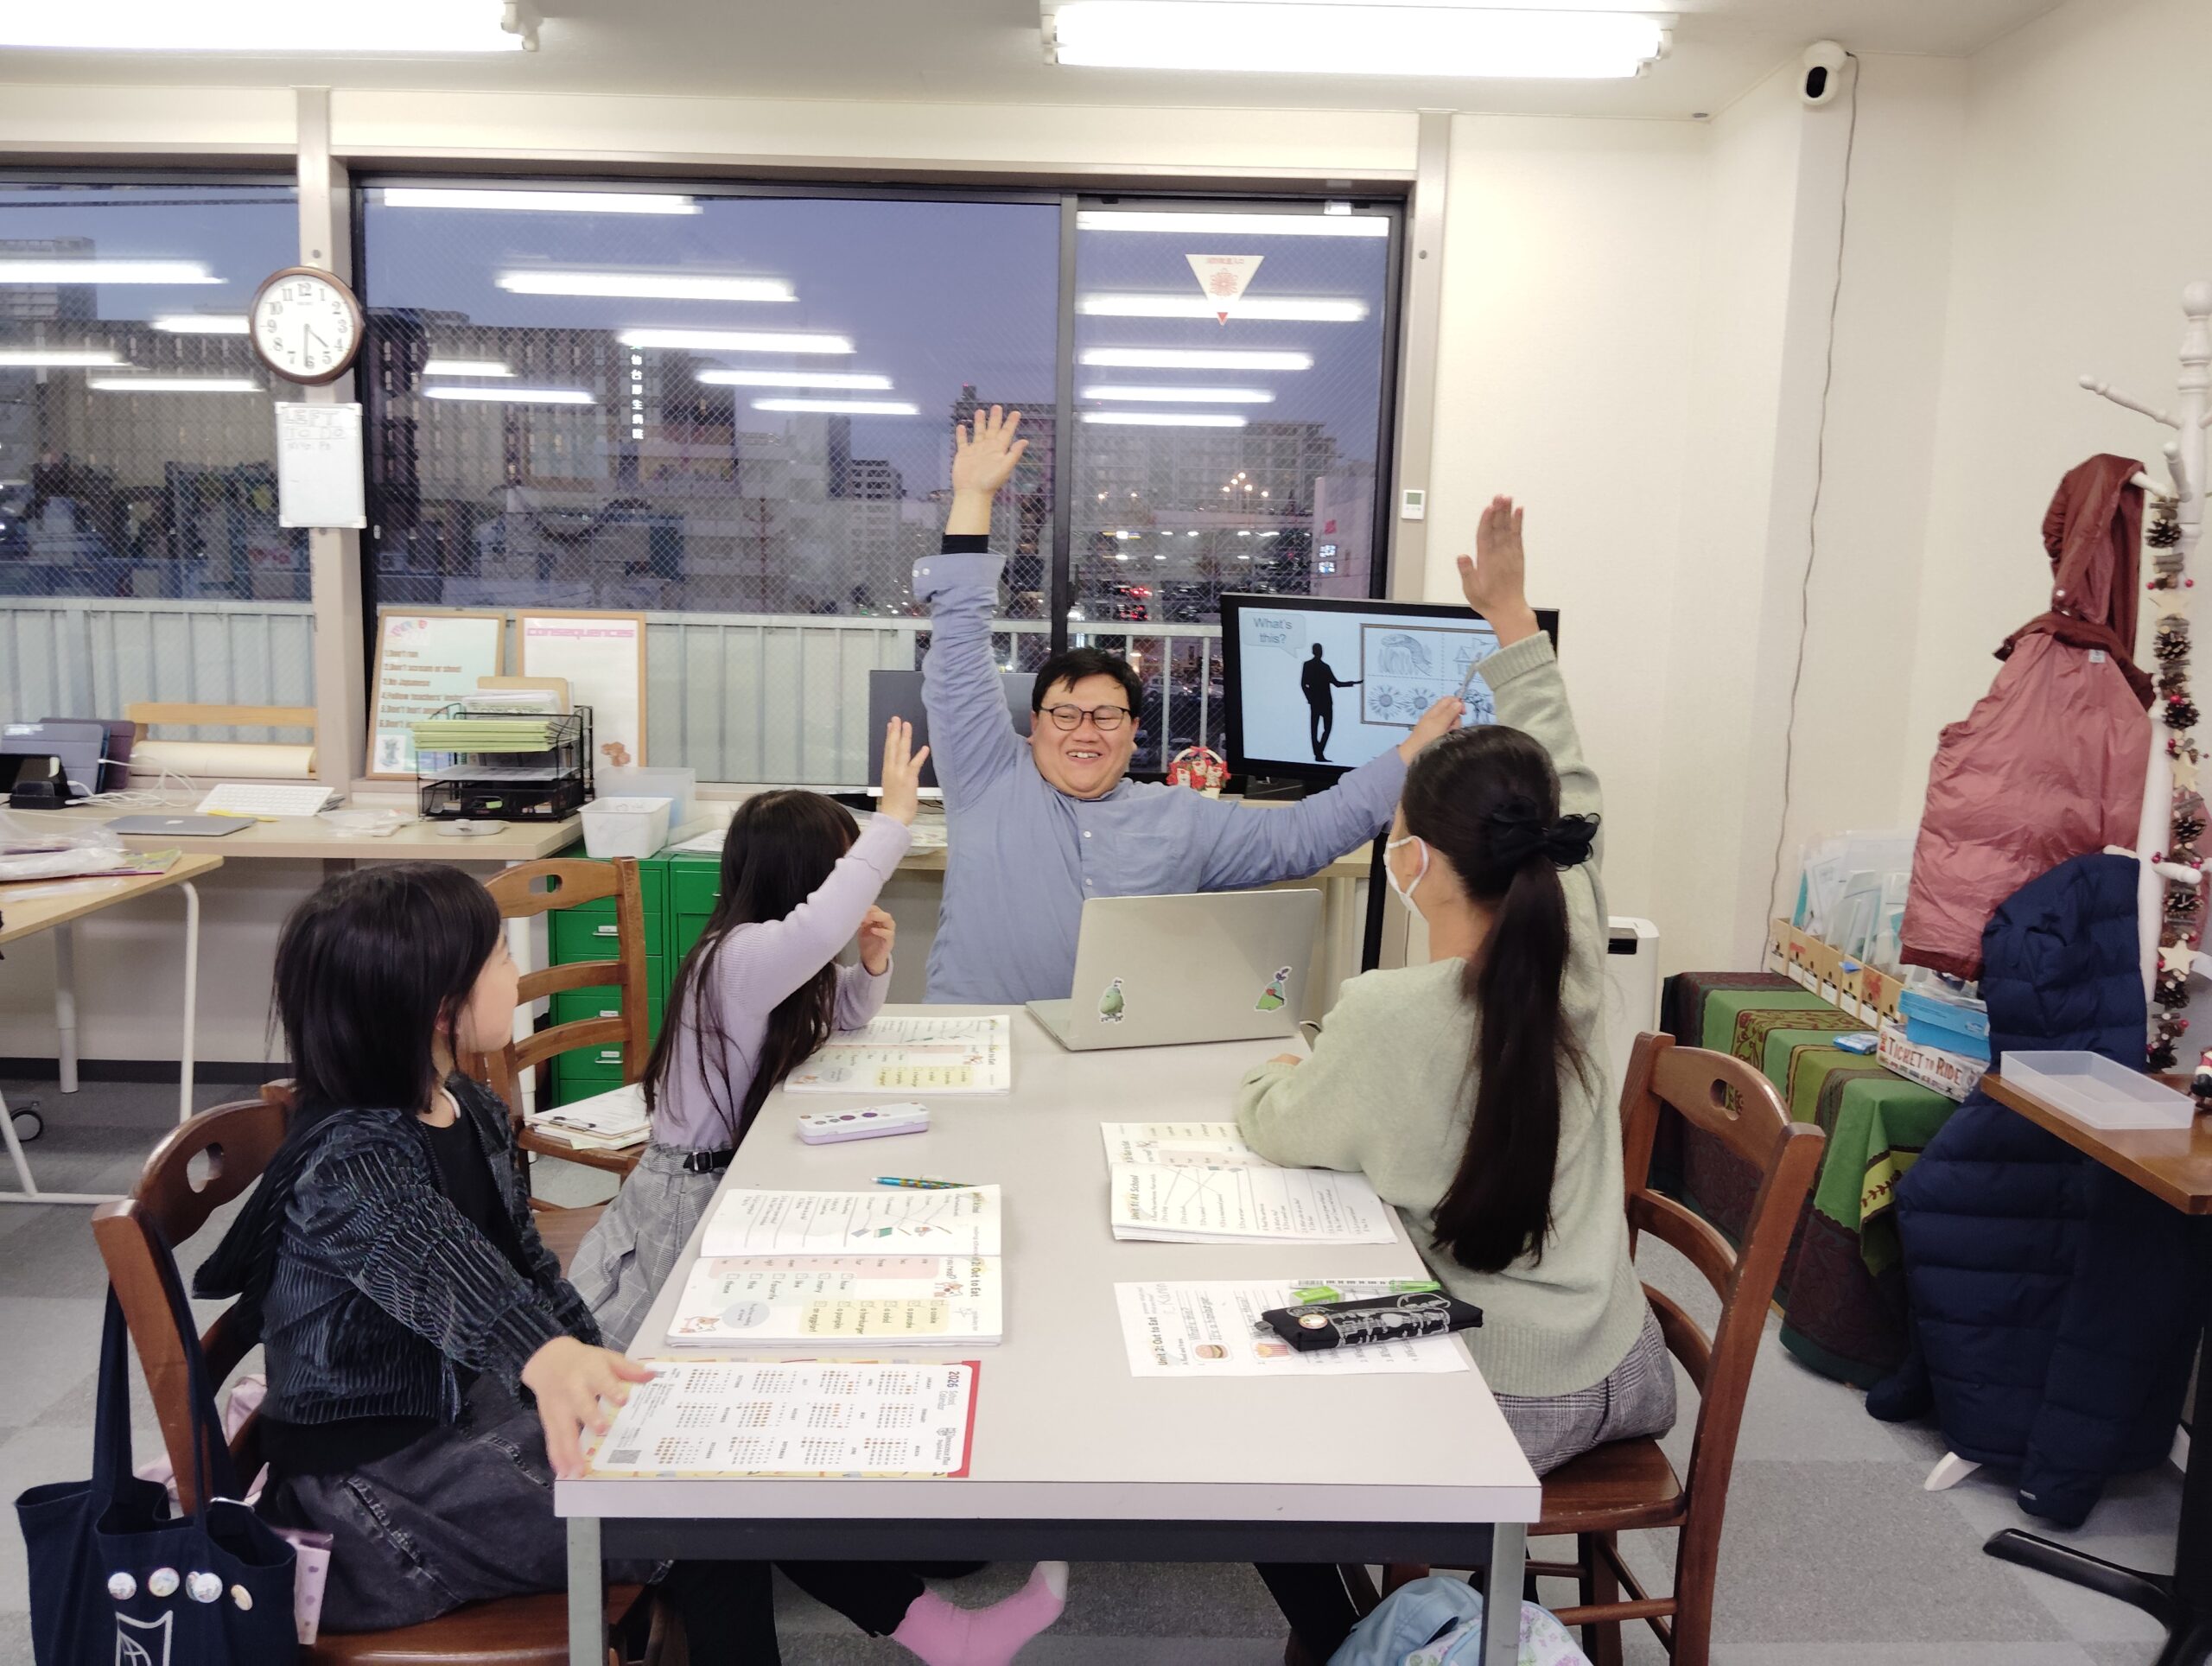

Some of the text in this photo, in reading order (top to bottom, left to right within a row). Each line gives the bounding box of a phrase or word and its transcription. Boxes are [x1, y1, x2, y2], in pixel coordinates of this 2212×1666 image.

[282, 288, 294, 302] 11
[297, 283, 312, 296] 12
[319, 288, 326, 301] 1
[270, 301, 283, 315] 10
[332, 301, 341, 315] 2
[267, 319, 277, 334] 9
[337, 319, 347, 334] 3
[273, 337, 283, 352] 8
[334, 338, 345, 352] 4
[287, 350, 296, 365] 7
[306, 355, 315, 370] 6
[322, 350, 333, 365] 5
[1253, 617, 1293, 630] What's
[1259, 633, 1287, 644] this?
[1886, 1037, 1924, 1069] TICKET
[1936, 1056, 1963, 1086] RIDE
[1129, 1175, 1139, 1192] School
[1129, 1208, 1140, 1219] Unit
[970, 1268, 982, 1277] Out
[722, 1281, 734, 1294] these
[747, 1281, 758, 1289] this
[767, 1281, 782, 1300] favorite
[814, 1281, 825, 1293] many
[840, 1281, 849, 1290] how
[970, 1288, 981, 1297] Eat
[808, 1314, 820, 1332] eggplant
[833, 1313, 843, 1329] pumpkin
[855, 1313, 869, 1334] hamburger
[882, 1313, 892, 1323] salad
[906, 1312, 915, 1328] pancake
[930, 1311, 940, 1324] cookie
[1147, 1317, 1159, 1326] Eat
[1151, 1334, 1163, 1345] Out
[1155, 1353, 1168, 1365] Unit
[947, 1371, 960, 1405] 2026 School
[938, 1391, 948, 1410] Calendar
